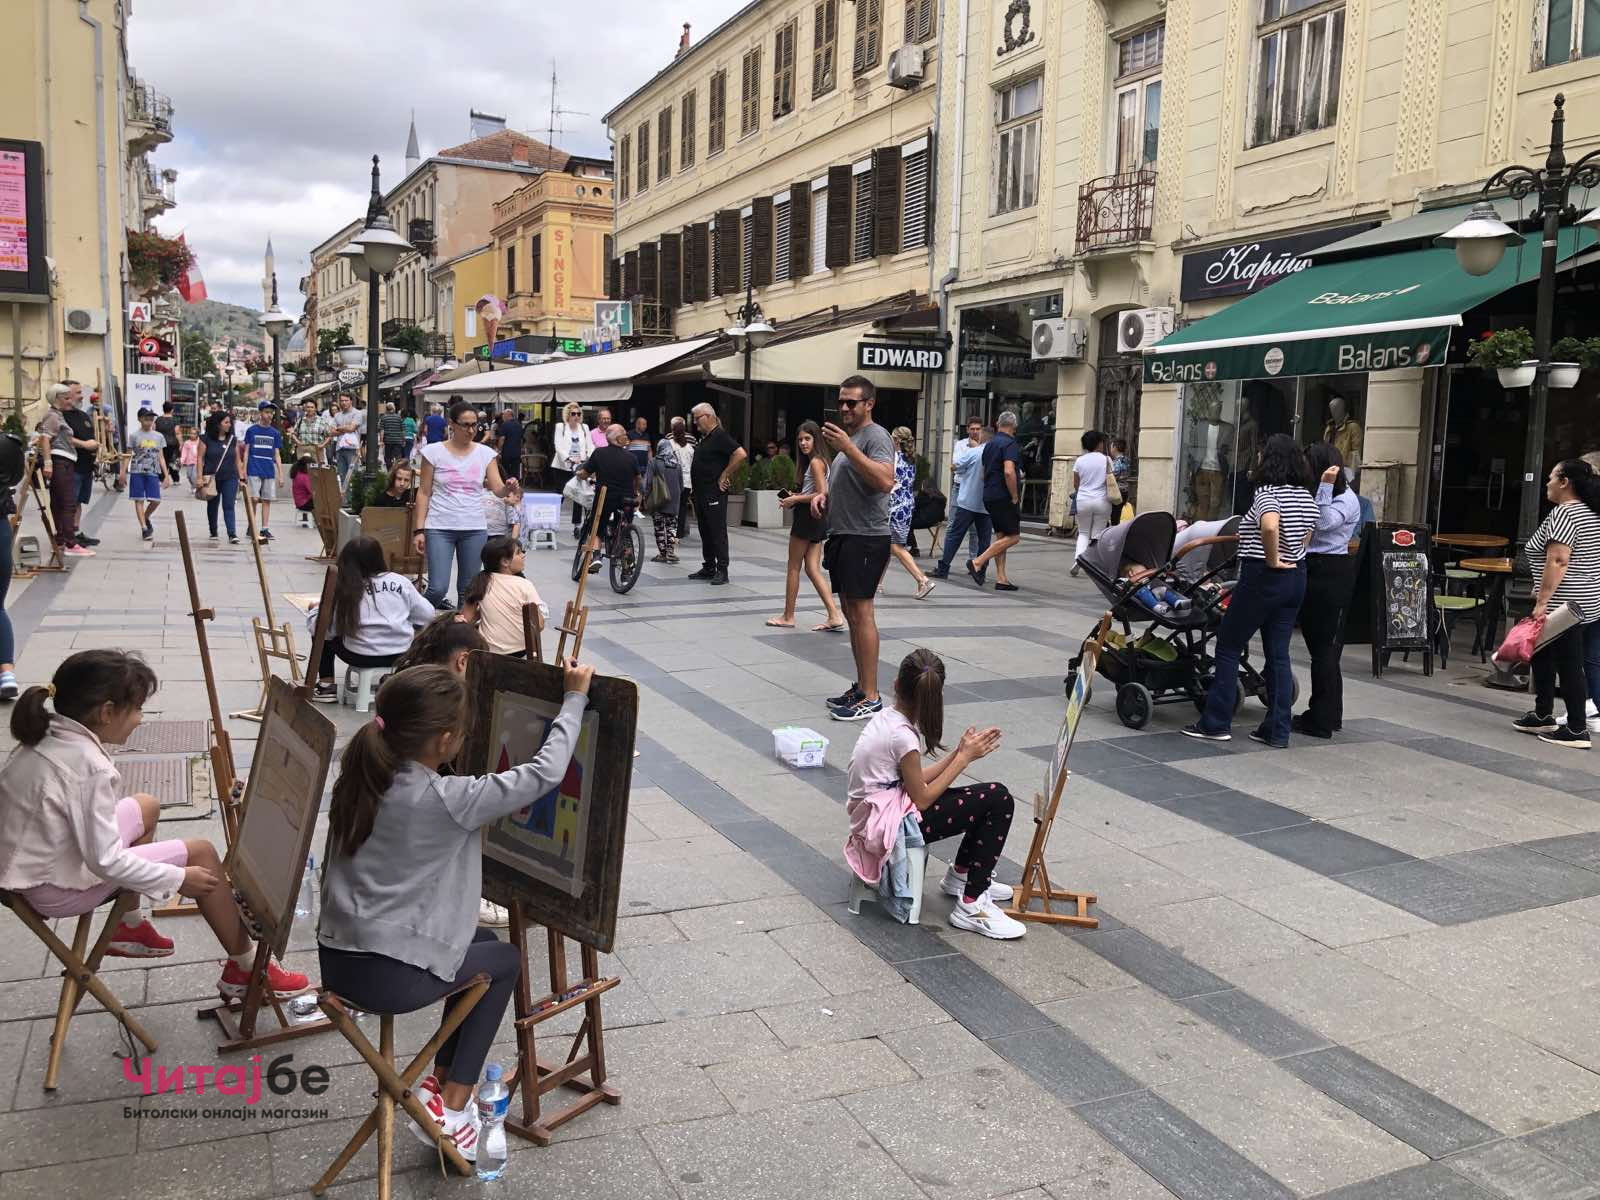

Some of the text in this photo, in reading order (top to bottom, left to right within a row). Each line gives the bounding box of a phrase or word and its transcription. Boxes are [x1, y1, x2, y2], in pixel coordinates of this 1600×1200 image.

[553, 229, 565, 308] SINGER
[862, 347, 943, 369] EDWARD
[1338, 342, 1411, 371] Balans
[1151, 359, 1202, 381] Balans
[135, 382, 157, 392] ROSA
